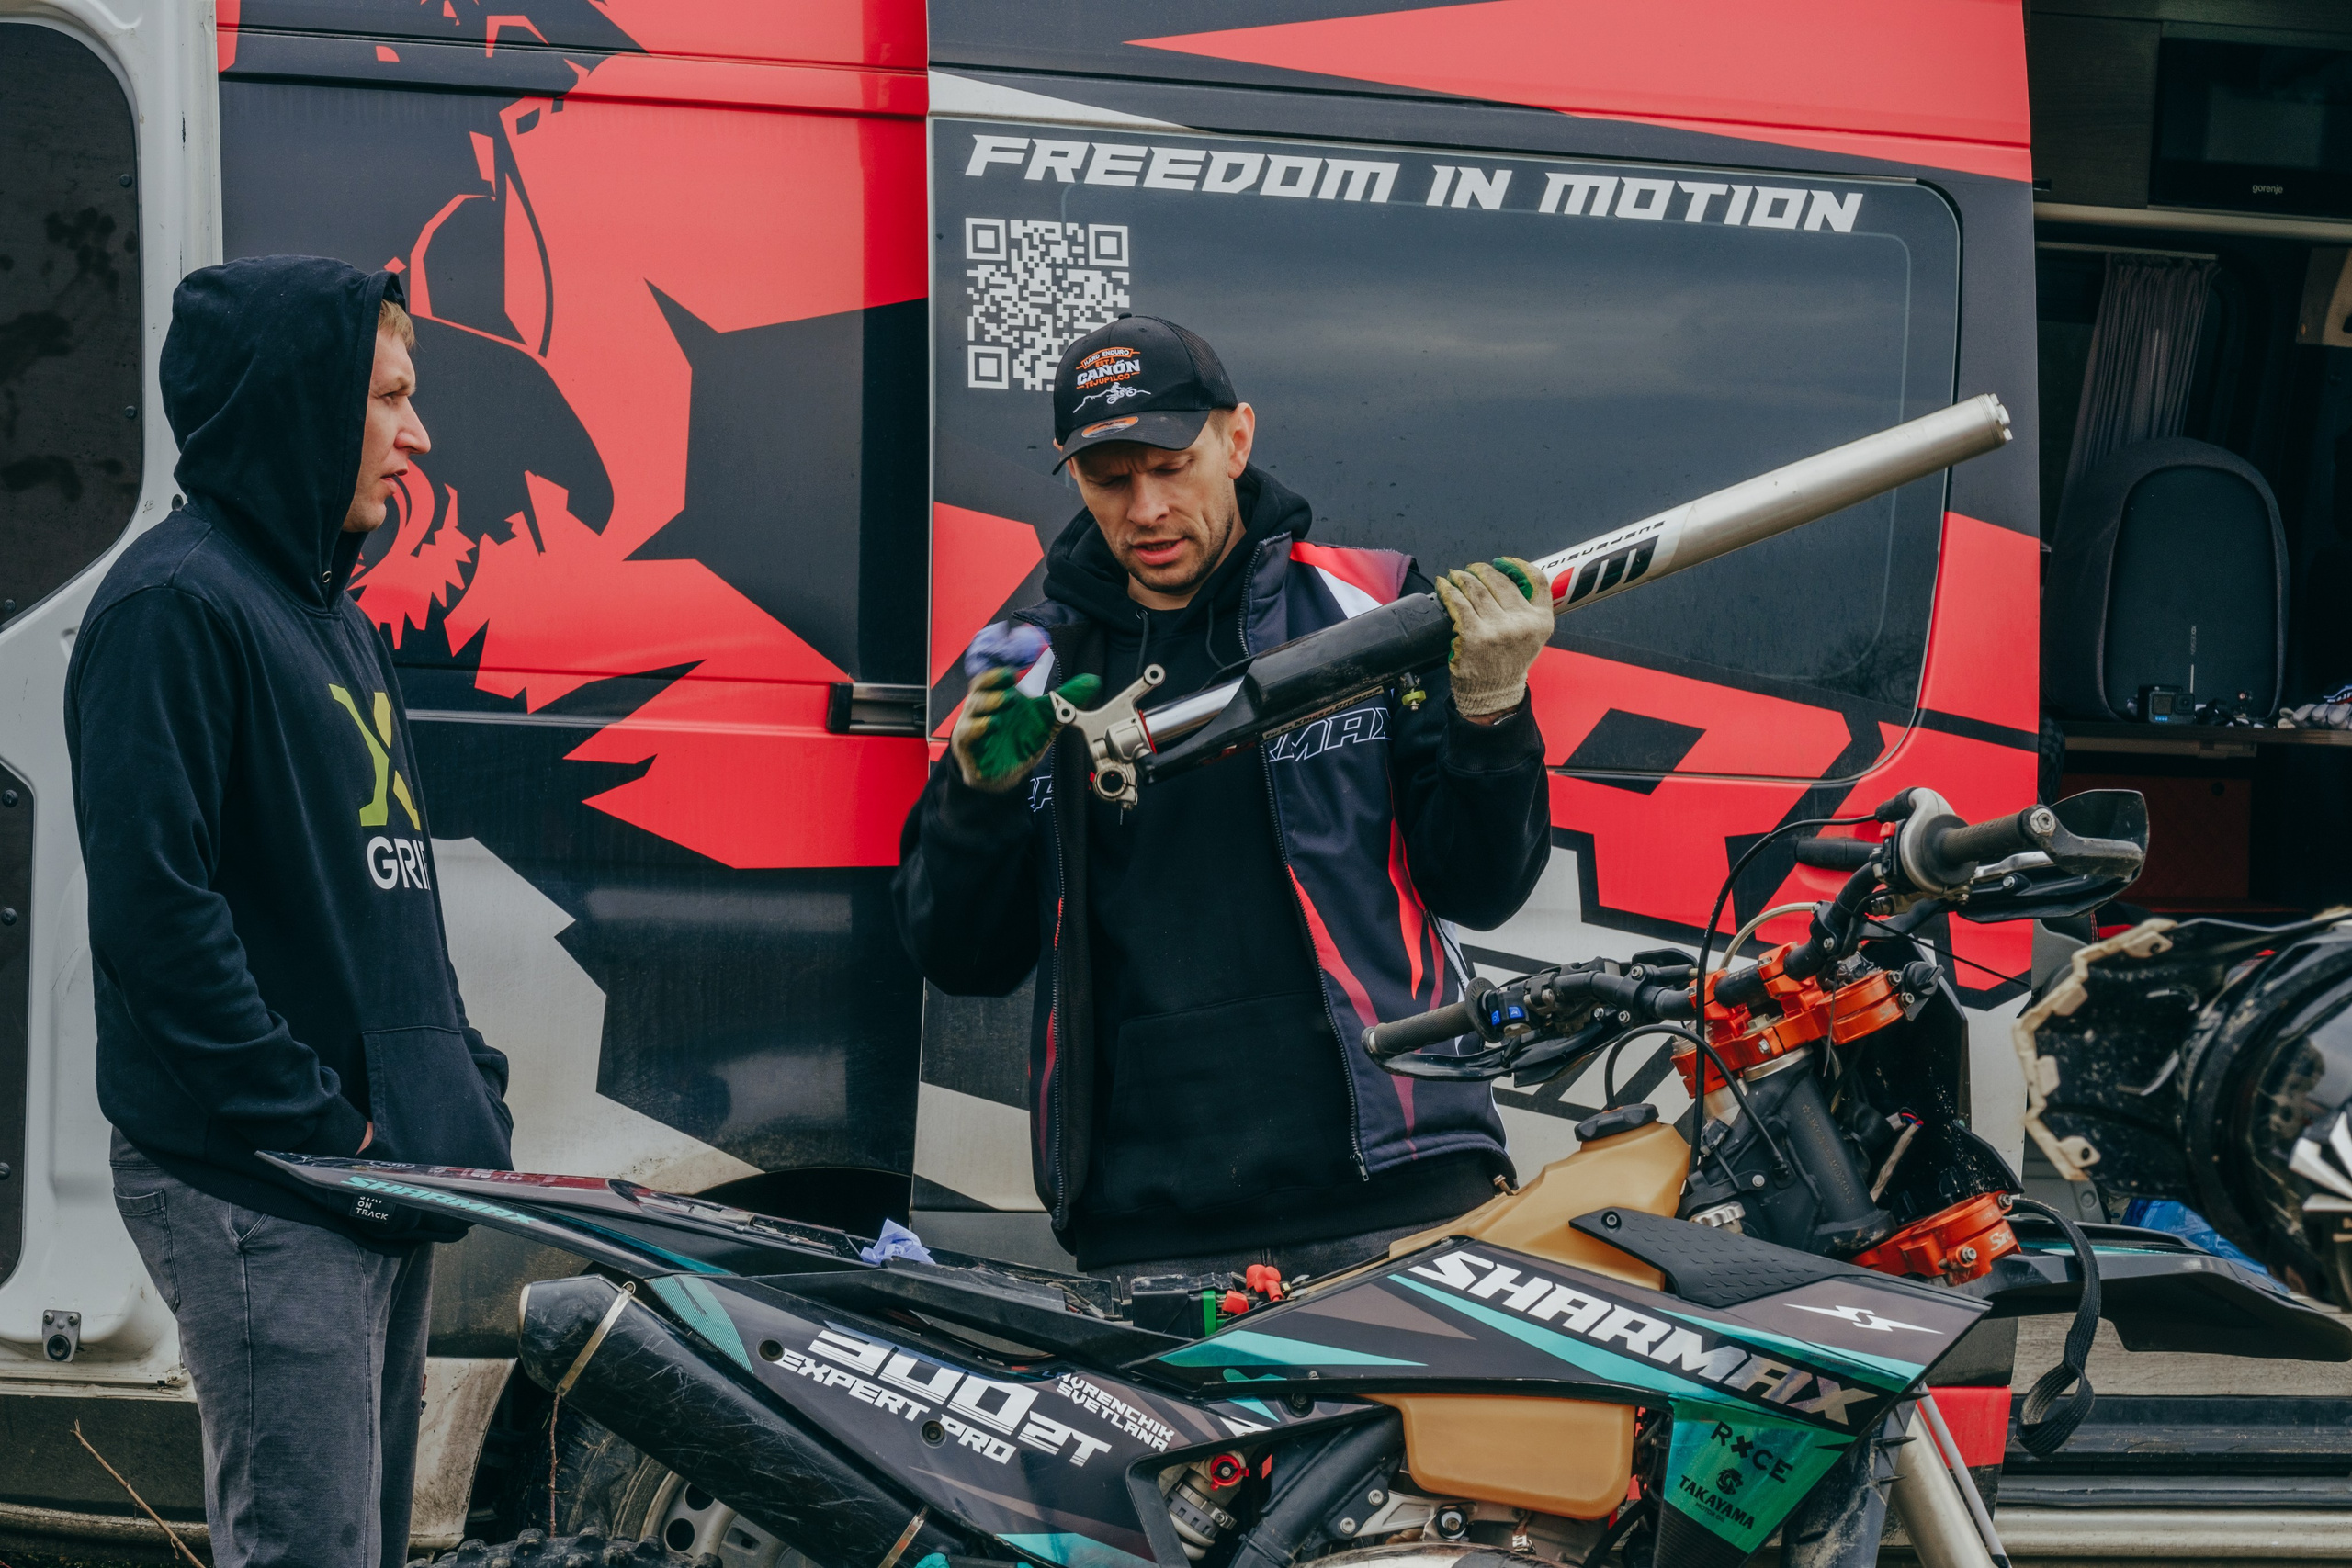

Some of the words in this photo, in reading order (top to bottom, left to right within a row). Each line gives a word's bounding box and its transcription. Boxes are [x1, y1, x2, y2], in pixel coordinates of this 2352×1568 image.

[965, 134, 1400, 203] FREEDOM
[1425, 164, 1512, 210] IN
[1538, 172, 1863, 233] MOTION
[2252, 184, 2283, 195] gorenje
[1083, 354, 1100, 366] HARD
[1102, 349, 1129, 357] ENDURO
[1085, 373, 1130, 389] TEJUPILCO
[341, 1176, 539, 1224] SHARMAX
[356, 1207, 389, 1220] TRACK
[357, 1200, 372, 1209] ON
[1408, 1250, 1879, 1426] SHARMAX
[773, 1348, 931, 1421] EXPERT
[940, 1414, 1017, 1465] PRO
[808, 1320, 1040, 1436] 300
[1017, 1410, 1113, 1467] 2T
[1057, 1381, 1169, 1453] SVETLANA
[1678, 1474, 1755, 1530] TAKAYAMA
[1695, 1502, 1715, 1517] MOTOR
